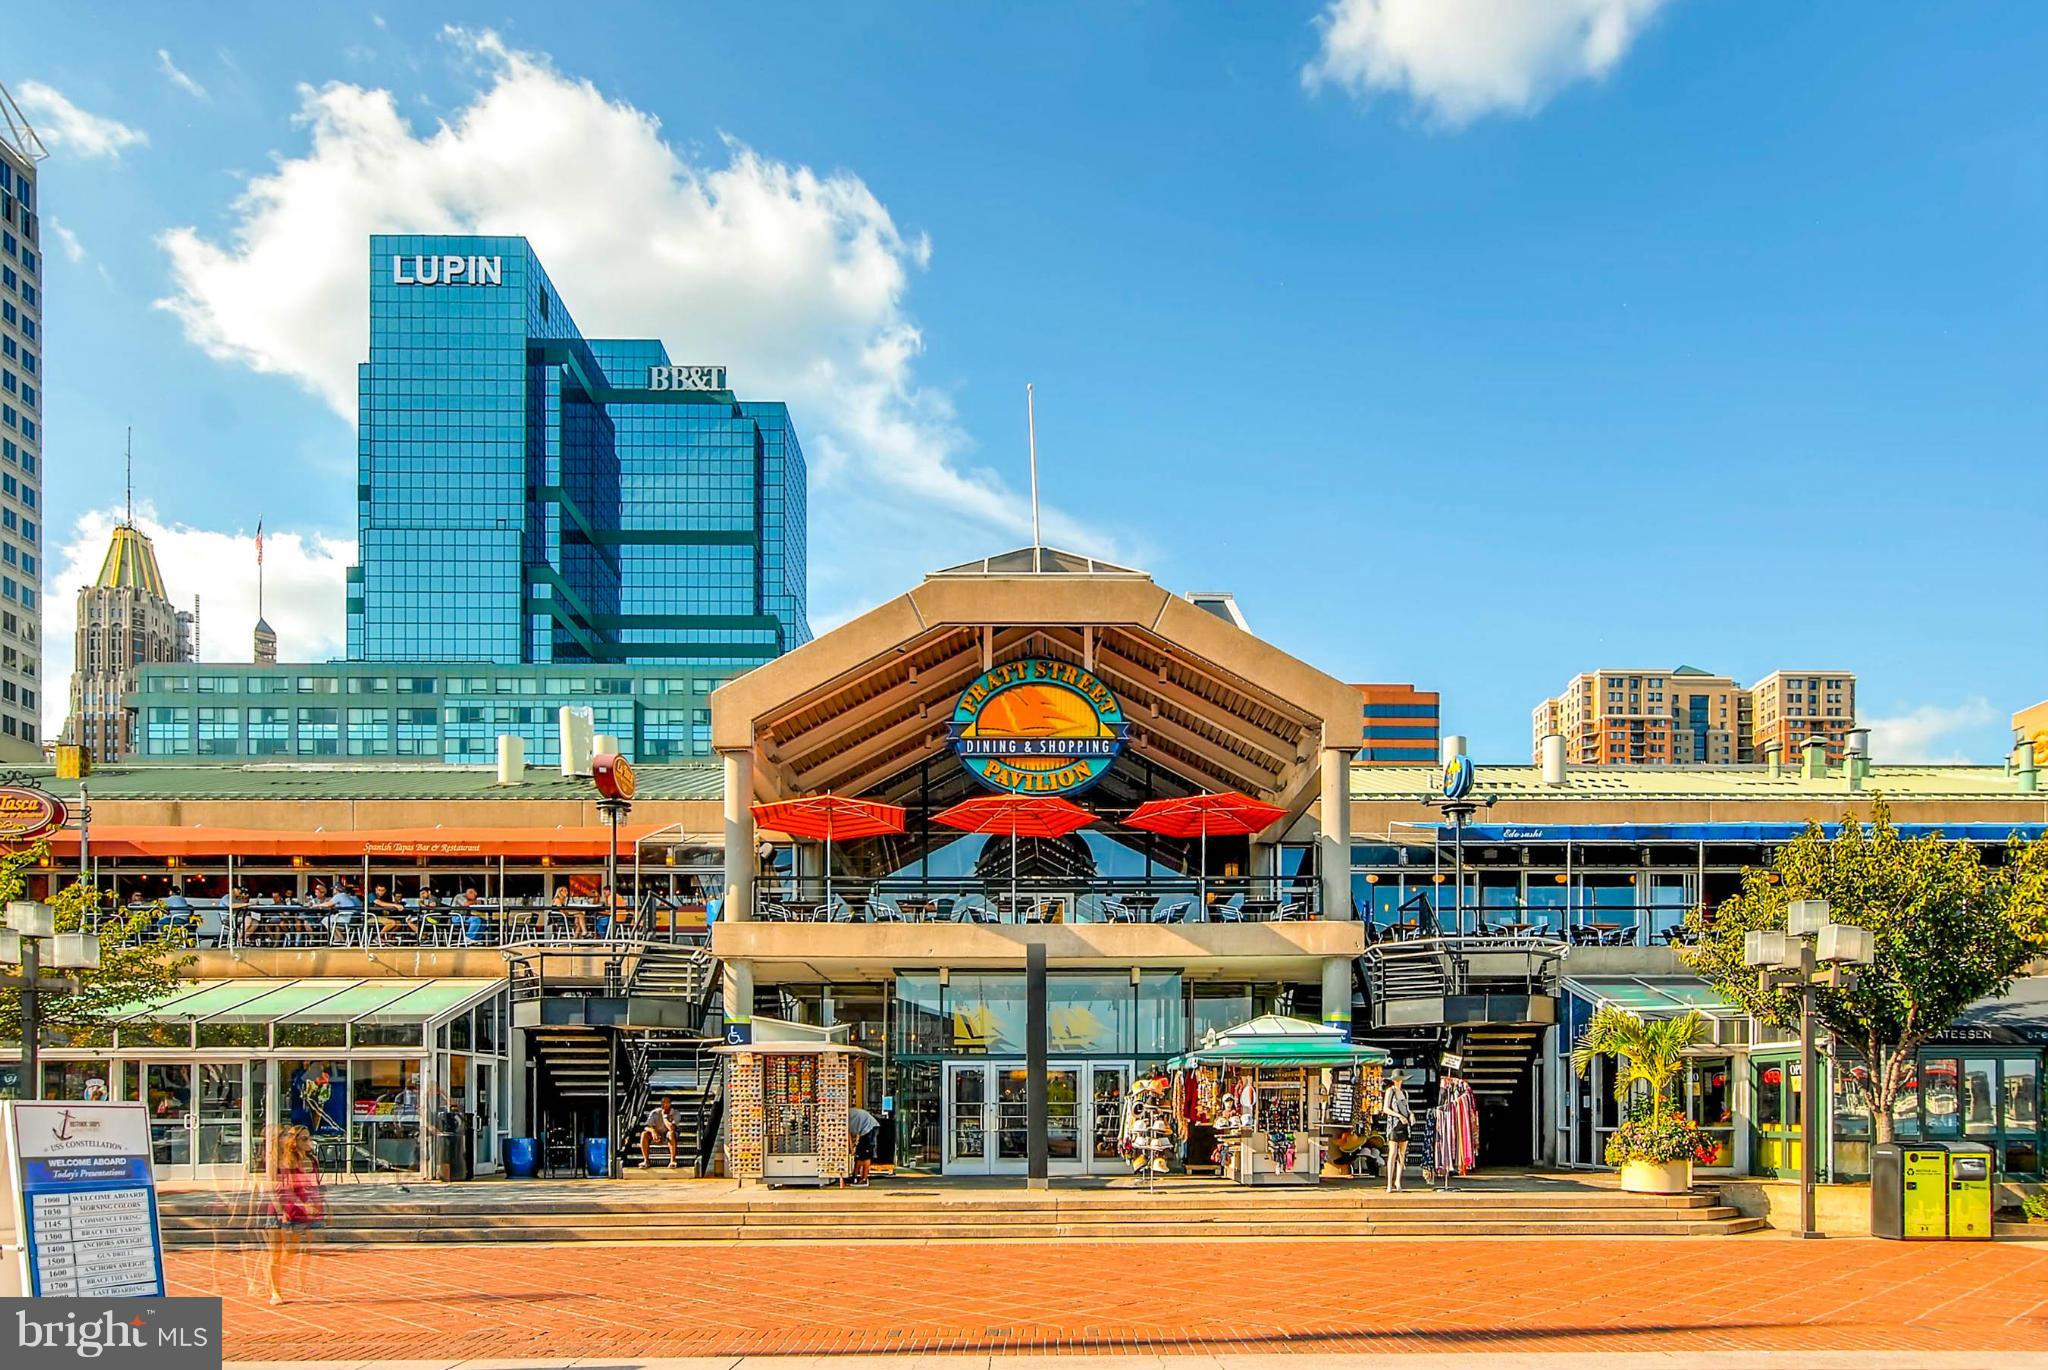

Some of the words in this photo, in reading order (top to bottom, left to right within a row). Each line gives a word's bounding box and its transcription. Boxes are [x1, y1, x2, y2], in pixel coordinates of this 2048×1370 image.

[393, 255, 502, 286] LUPIN
[648, 365, 727, 392] BB&T
[959, 661, 1028, 715] PRATT
[1034, 661, 1118, 715] STREET
[966, 740, 1017, 753] DINING
[1024, 740, 1033, 753] &
[1040, 740, 1110, 753] SHOPPING
[983, 759, 1092, 792] PAVILION
[0, 794, 40, 811] Tasca
[363, 842, 392, 854] Spanish
[393, 842, 415, 855] Tapas
[416, 843, 430, 851] Bar
[440, 843, 481, 852] Restaurant
[1927, 1030, 1992, 1039] CATESSEN
[65, 1140, 122, 1151] CONSTELLATION
[48, 1159, 92, 1167] WELCOME
[93, 1158, 127, 1166] ABOARD
[53, 1170, 79, 1180] Today's
[80, 1168, 127, 1177] Presentations
[72, 1193, 111, 1202] WELCOME
[80, 1204, 113, 1212] MORNING
[82, 1239, 115, 1248] ANCHORS
[84, 1263, 117, 1272] ANCHORS
[50, 1282, 68, 1290] 1700
[92, 1288, 109, 1296] LAST
